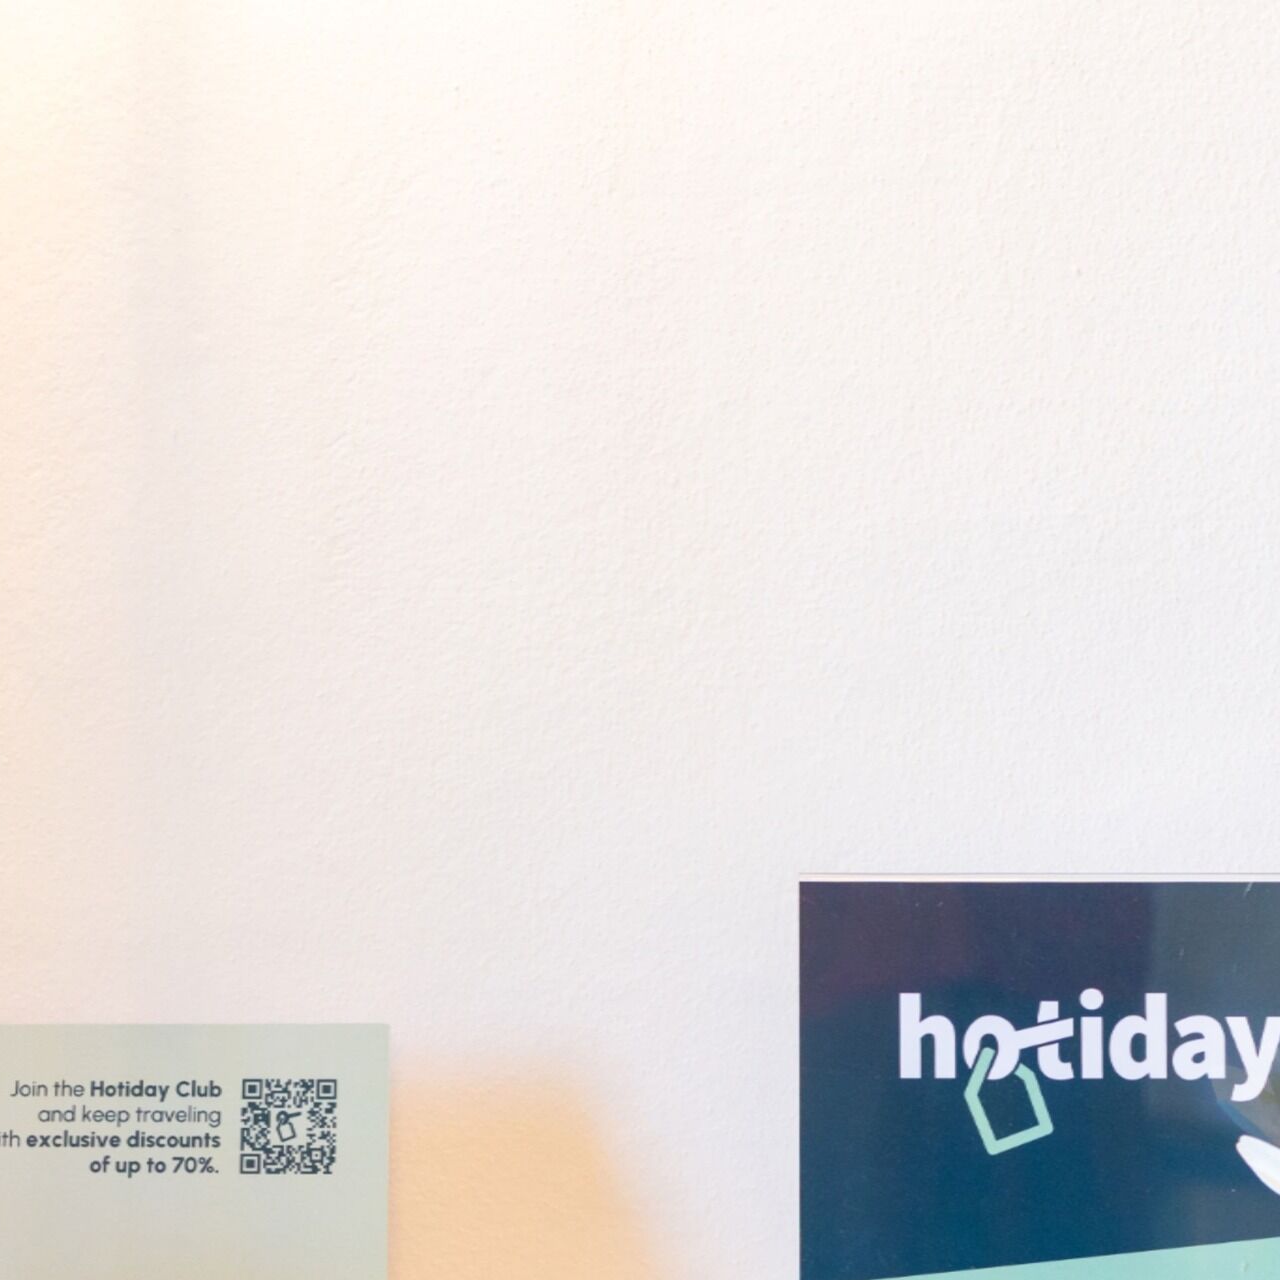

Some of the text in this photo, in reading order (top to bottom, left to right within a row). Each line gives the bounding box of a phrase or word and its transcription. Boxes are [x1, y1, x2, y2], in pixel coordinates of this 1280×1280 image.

[10, 1080, 222, 1102] Join the Hotiday Club
[38, 1106, 222, 1128] and keep traveling
[25, 1131, 120, 1149] exclusive
[126, 1131, 221, 1149] discounts
[90, 1156, 220, 1178] of up to 70%.
